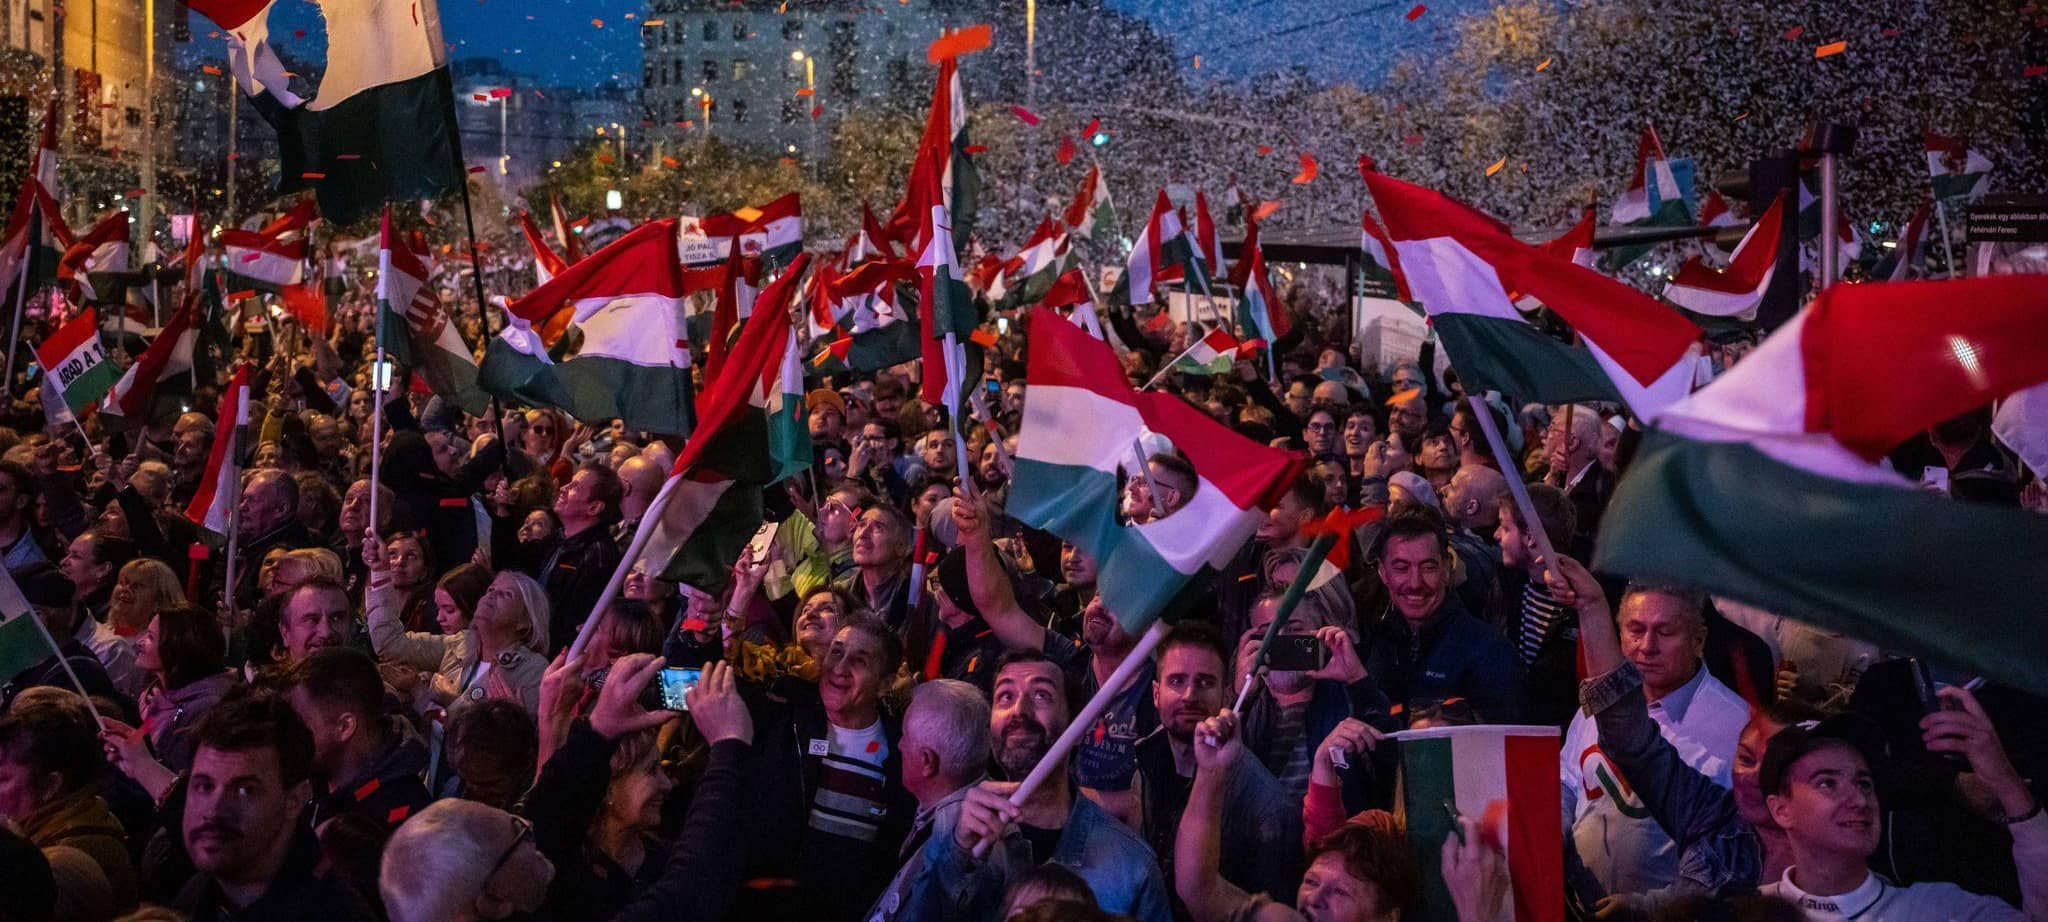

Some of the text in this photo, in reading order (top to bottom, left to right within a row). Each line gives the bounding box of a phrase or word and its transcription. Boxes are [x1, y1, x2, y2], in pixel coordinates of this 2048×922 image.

[1998, 214, 2009, 222] egy
[57, 358, 84, 388] ÁRAD
[83, 350, 97, 368] A
